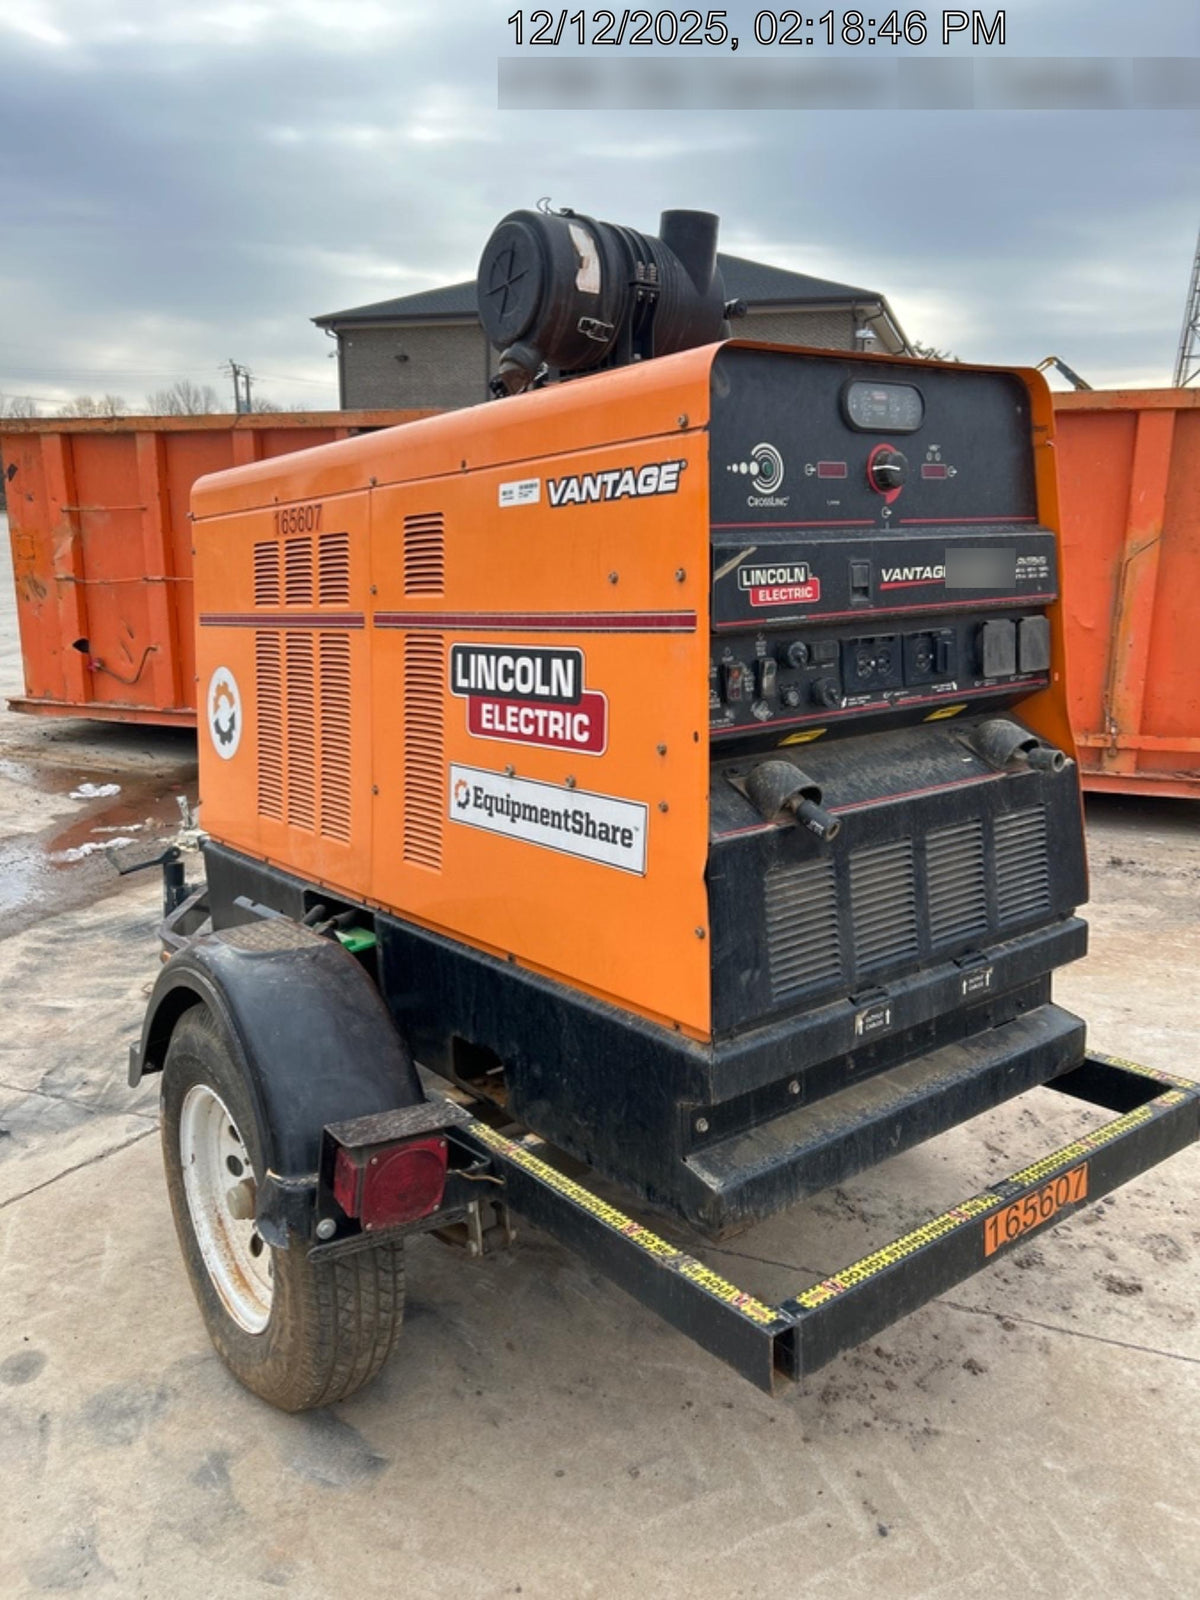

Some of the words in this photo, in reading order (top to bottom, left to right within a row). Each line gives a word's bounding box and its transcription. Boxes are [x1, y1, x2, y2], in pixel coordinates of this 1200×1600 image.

[547, 461, 682, 507] VANTAGE
[274, 503, 322, 535] 165607
[742, 566, 806, 586] LINCOLN
[758, 586, 814, 602] ELECTRIC
[881, 565, 946, 582] VANTAG
[455, 652, 575, 698] LINCOLN
[480, 702, 591, 743] ELECTRIC
[472, 784, 634, 849] EquipmentShare
[988, 1164, 1086, 1249] 165607
[839, 1269, 863, 1285] DO
[859, 1254, 889, 1277] NOT
[884, 1232, 926, 1259] STAND
